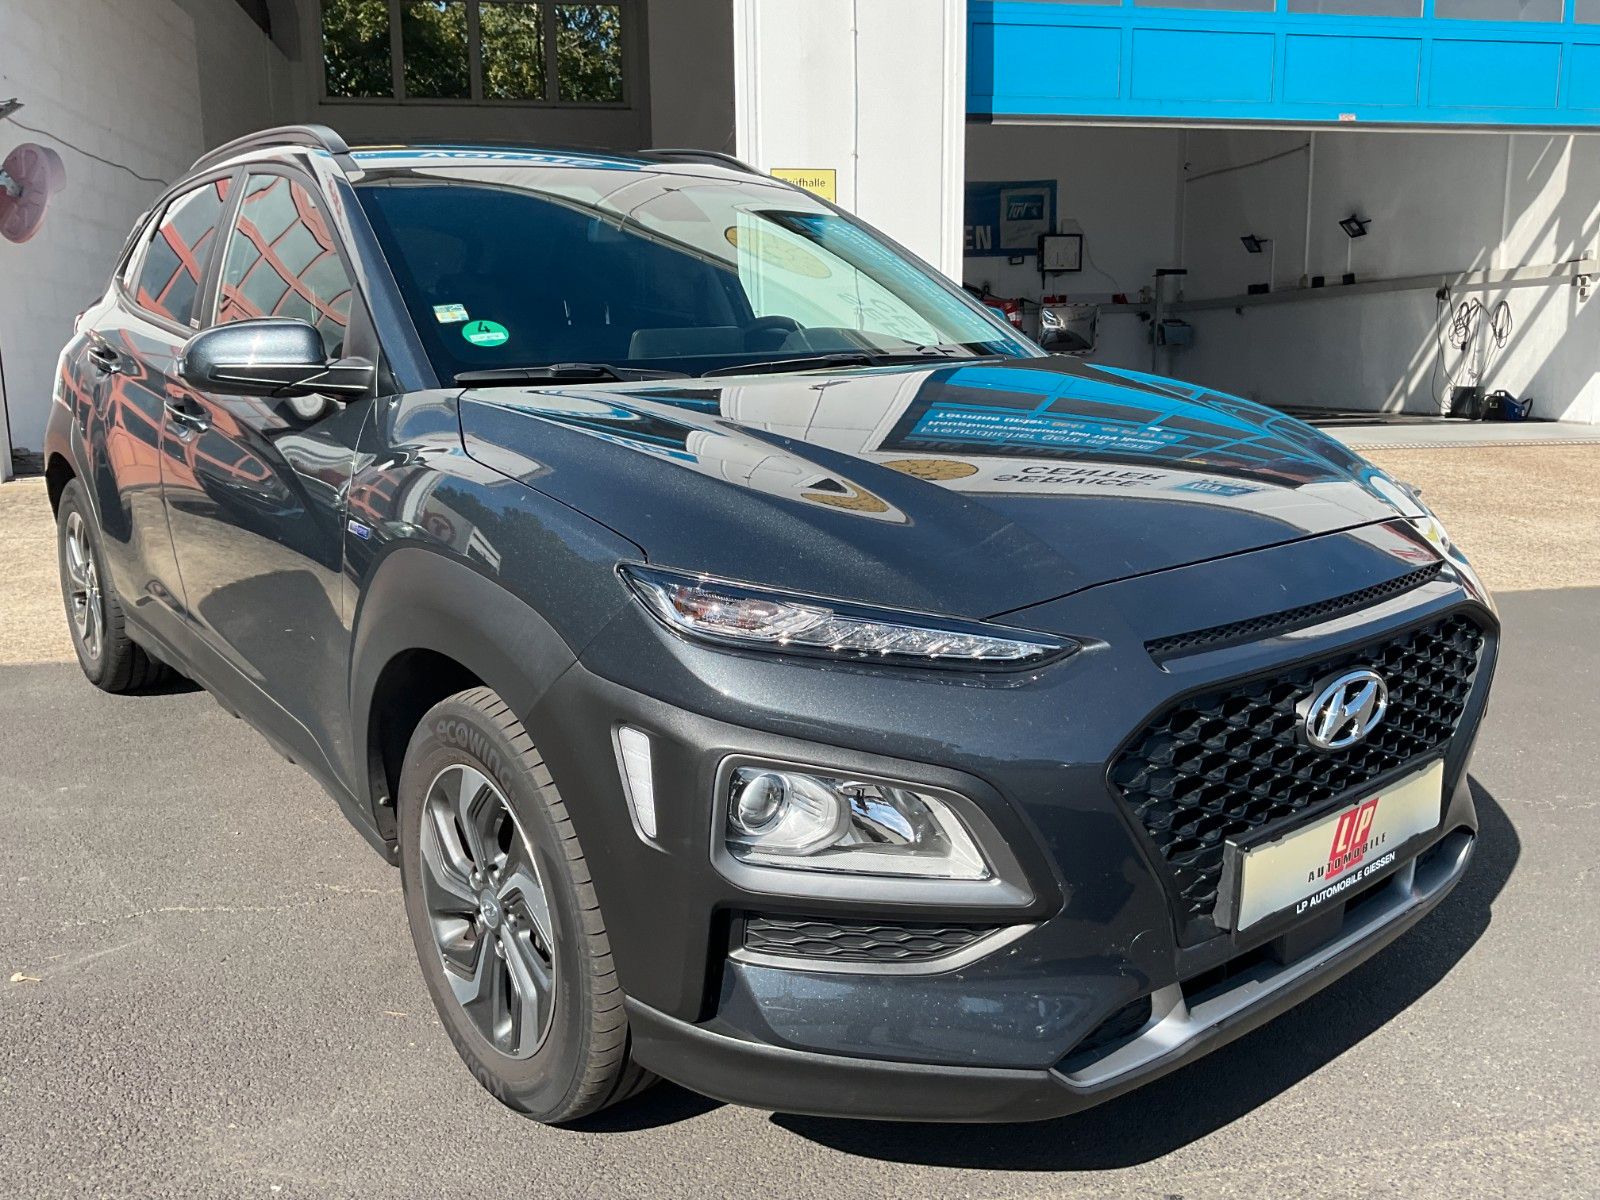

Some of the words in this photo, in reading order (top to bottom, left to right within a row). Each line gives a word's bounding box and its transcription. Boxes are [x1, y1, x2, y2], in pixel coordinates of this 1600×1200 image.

[477, 321, 491, 333] 4
[1336, 806, 1376, 852] LP
[1308, 832, 1387, 883] AUTOMOBILE
[1296, 901, 1308, 914] LP
[1309, 870, 1363, 908] AUTOMOBILE
[1363, 851, 1396, 877] GIESSEN
